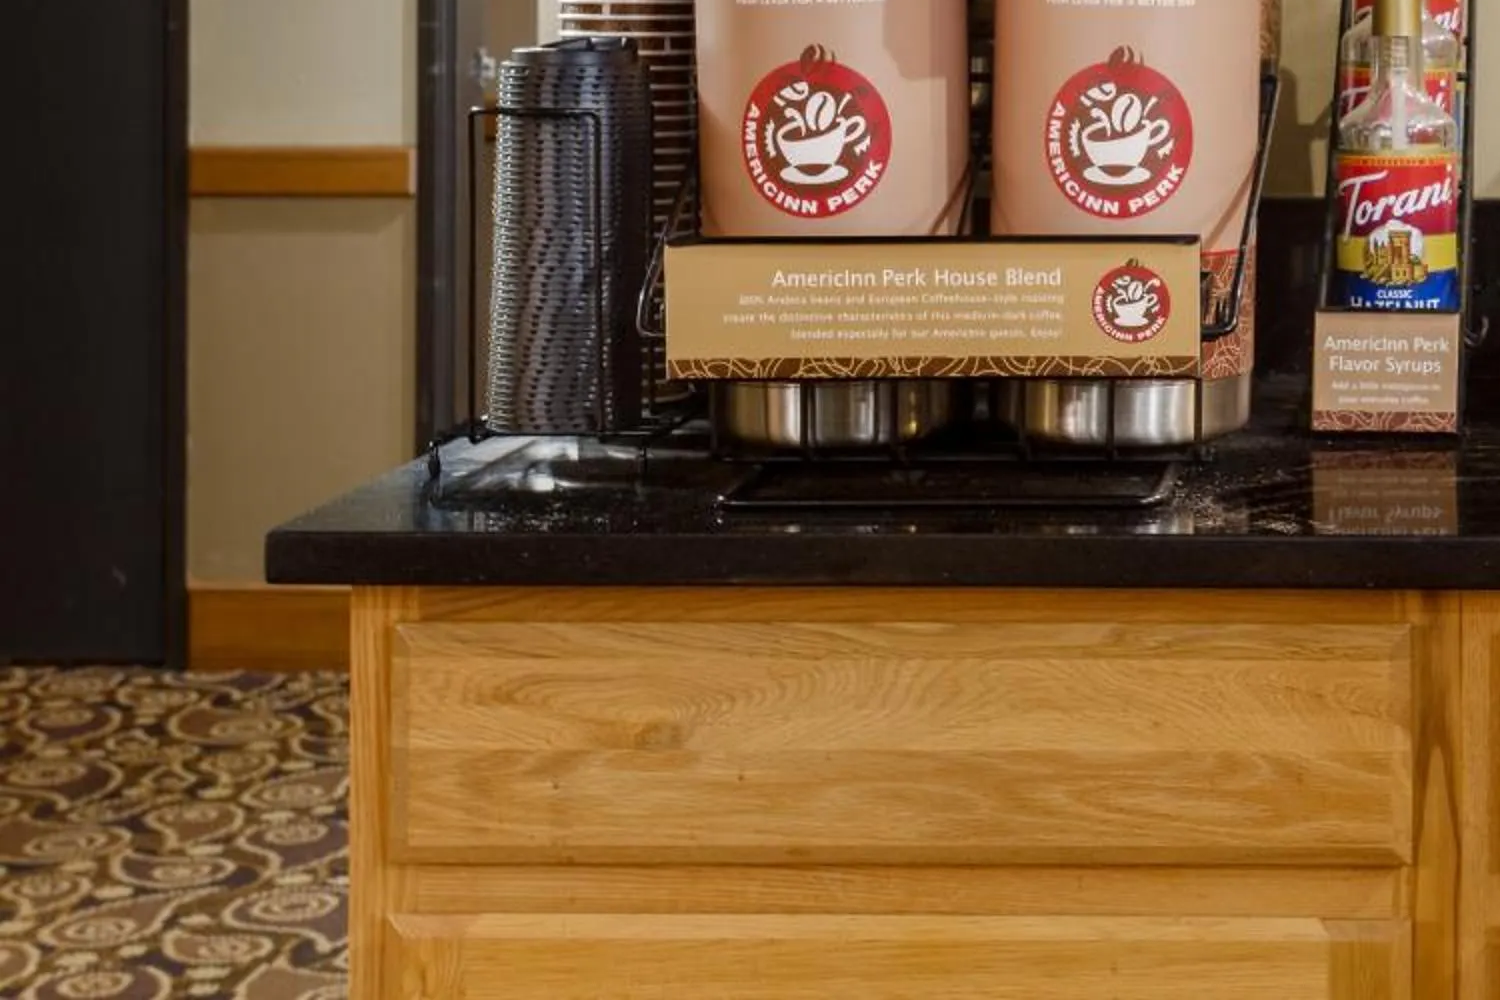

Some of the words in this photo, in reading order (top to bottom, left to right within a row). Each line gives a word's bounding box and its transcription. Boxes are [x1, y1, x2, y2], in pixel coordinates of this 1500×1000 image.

[744, 103, 818, 214] AMERICINN
[827, 159, 884, 212] PERK
[1047, 101, 1120, 215] AMERICINN
[1127, 163, 1184, 213] PERK
[1338, 162, 1454, 243] Torani
[771, 269, 876, 288] AmericInn
[883, 268, 927, 287] Perk
[934, 267, 999, 287] House
[1005, 267, 1062, 287] Blend
[845, 293, 866, 305] and
[1375, 288, 1414, 300] CLASSIC
[1323, 335, 1410, 353] AmericInn
[1413, 334, 1450, 353] Perk
[1328, 355, 1380, 371] Flavor
[1385, 356, 1442, 376] Syrups
